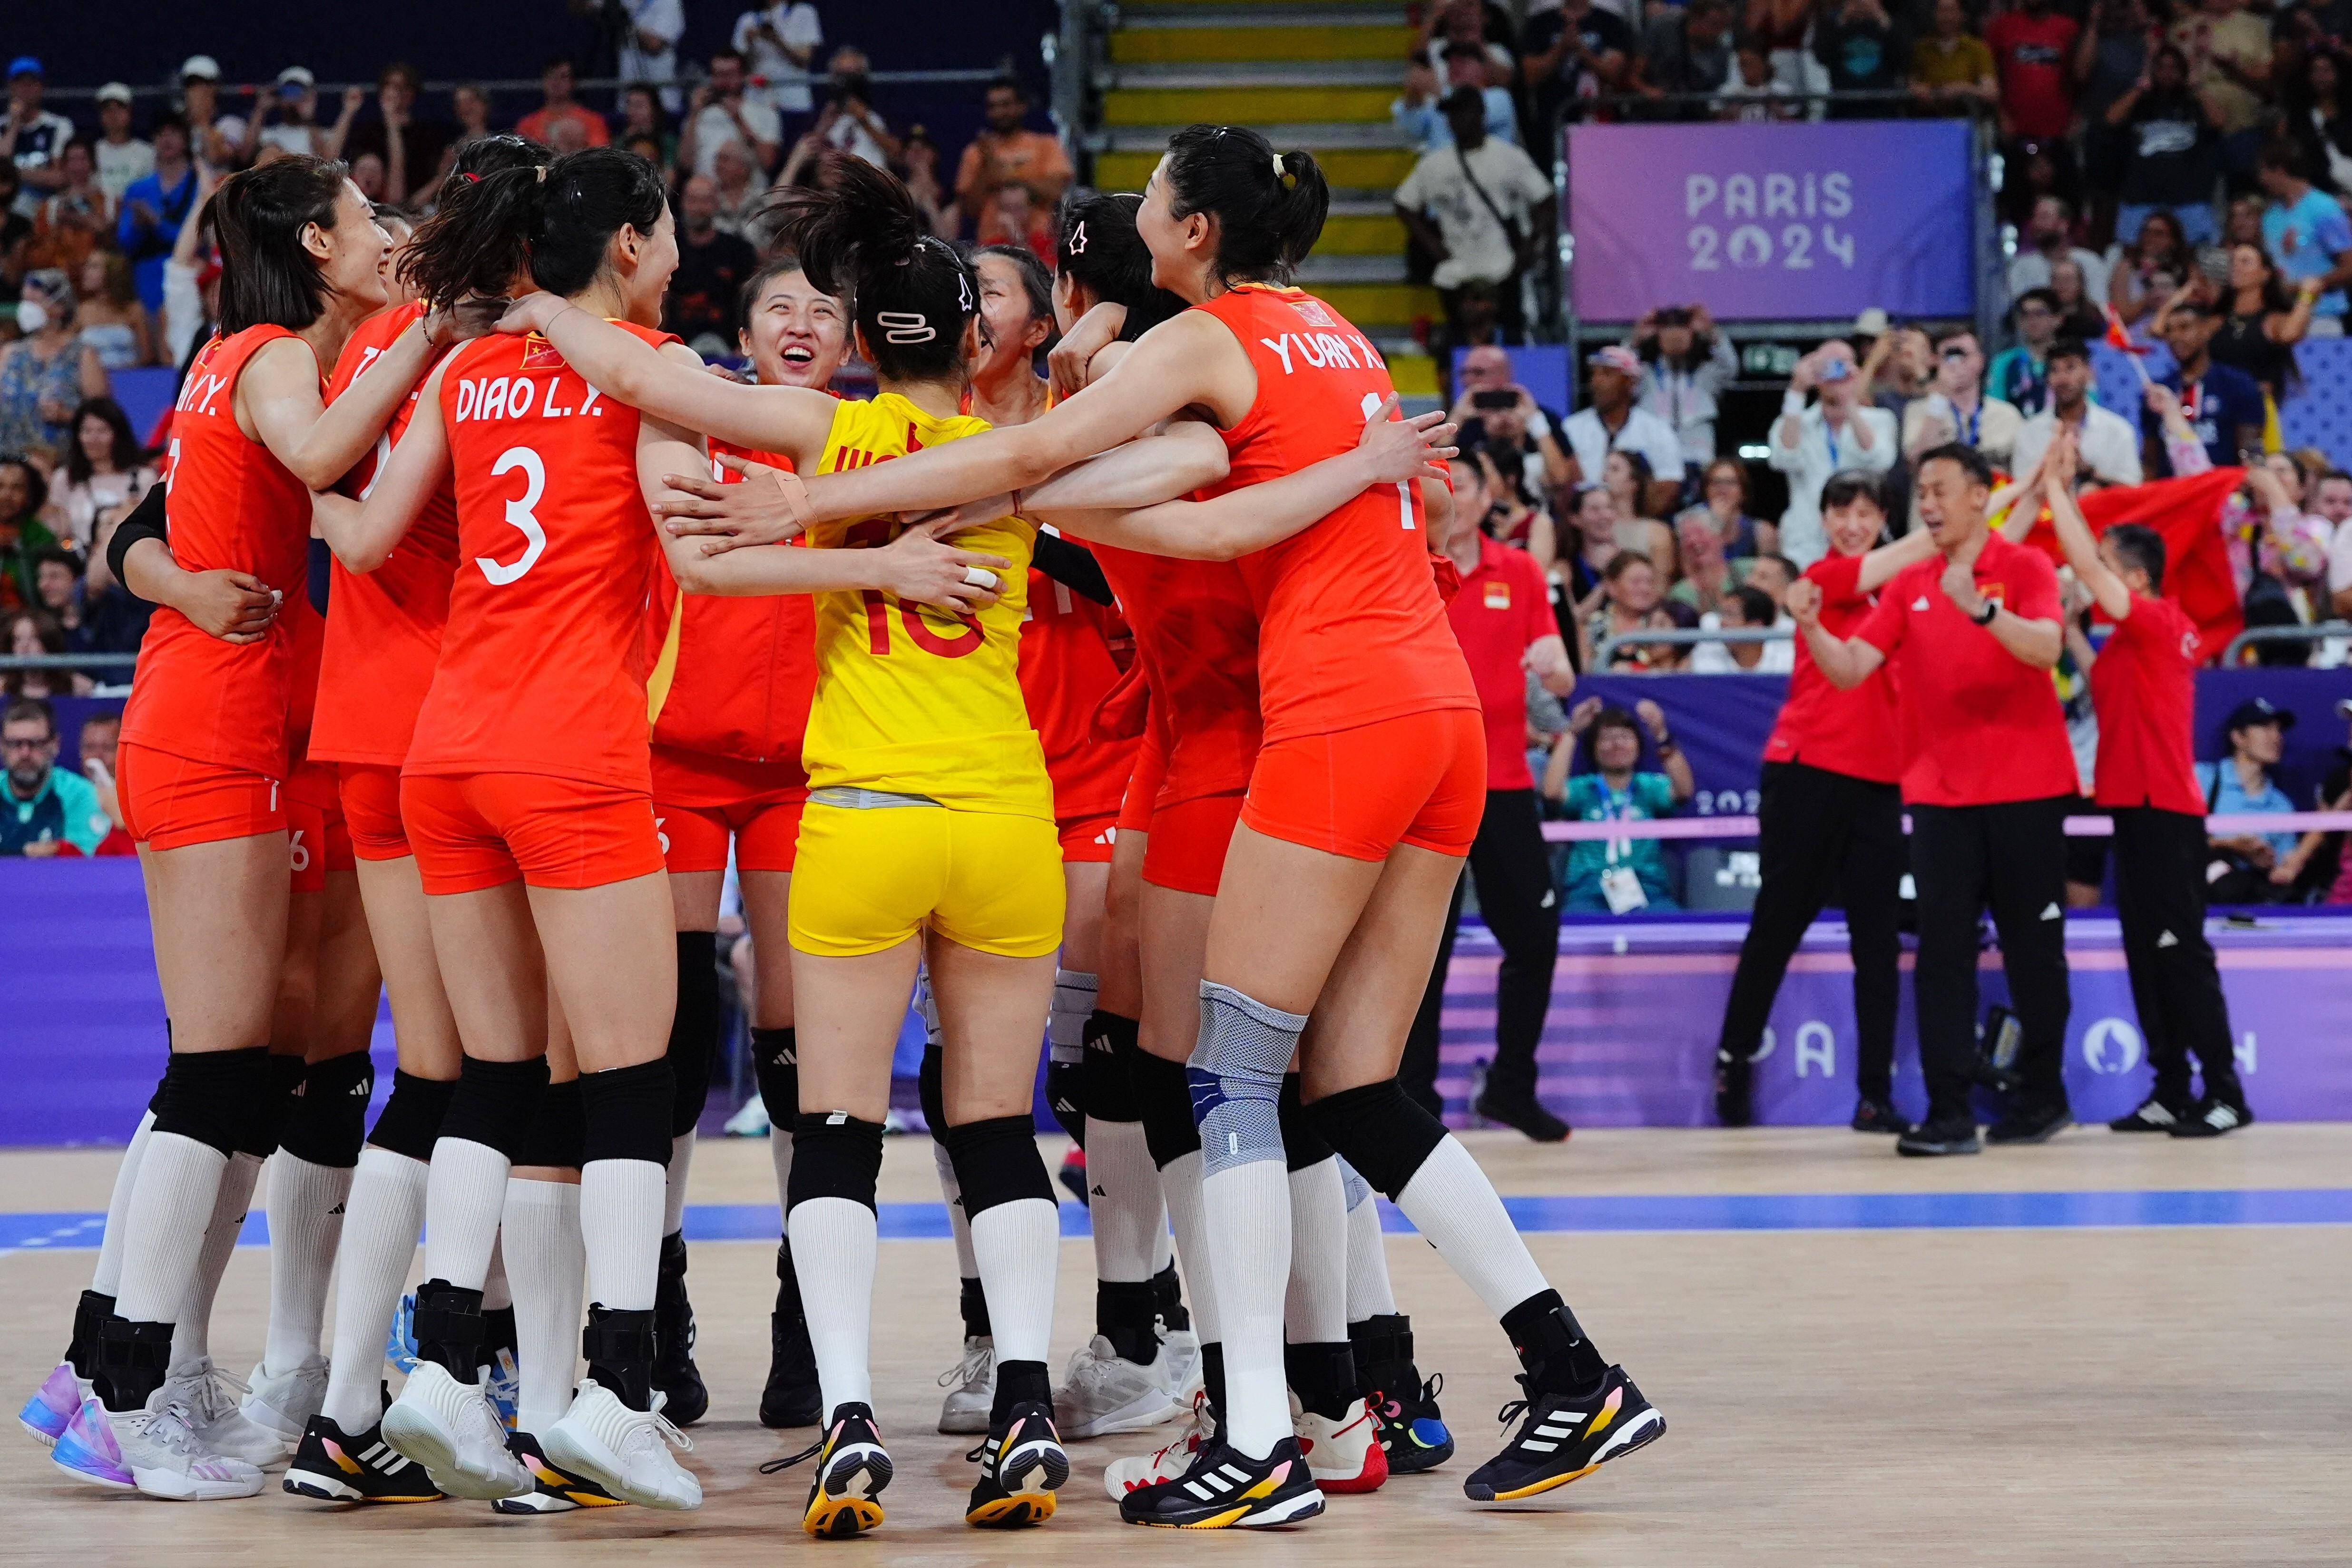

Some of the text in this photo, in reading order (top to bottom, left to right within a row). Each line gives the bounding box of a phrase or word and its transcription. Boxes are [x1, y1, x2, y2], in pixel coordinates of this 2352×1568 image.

[1686, 171, 1852, 218] PARIS
[1687, 224, 1854, 270] 2024
[1260, 333, 1361, 375] YUAN
[456, 377, 535, 423] DIAO
[542, 377, 572, 417] L.
[475, 446, 547, 586] 3
